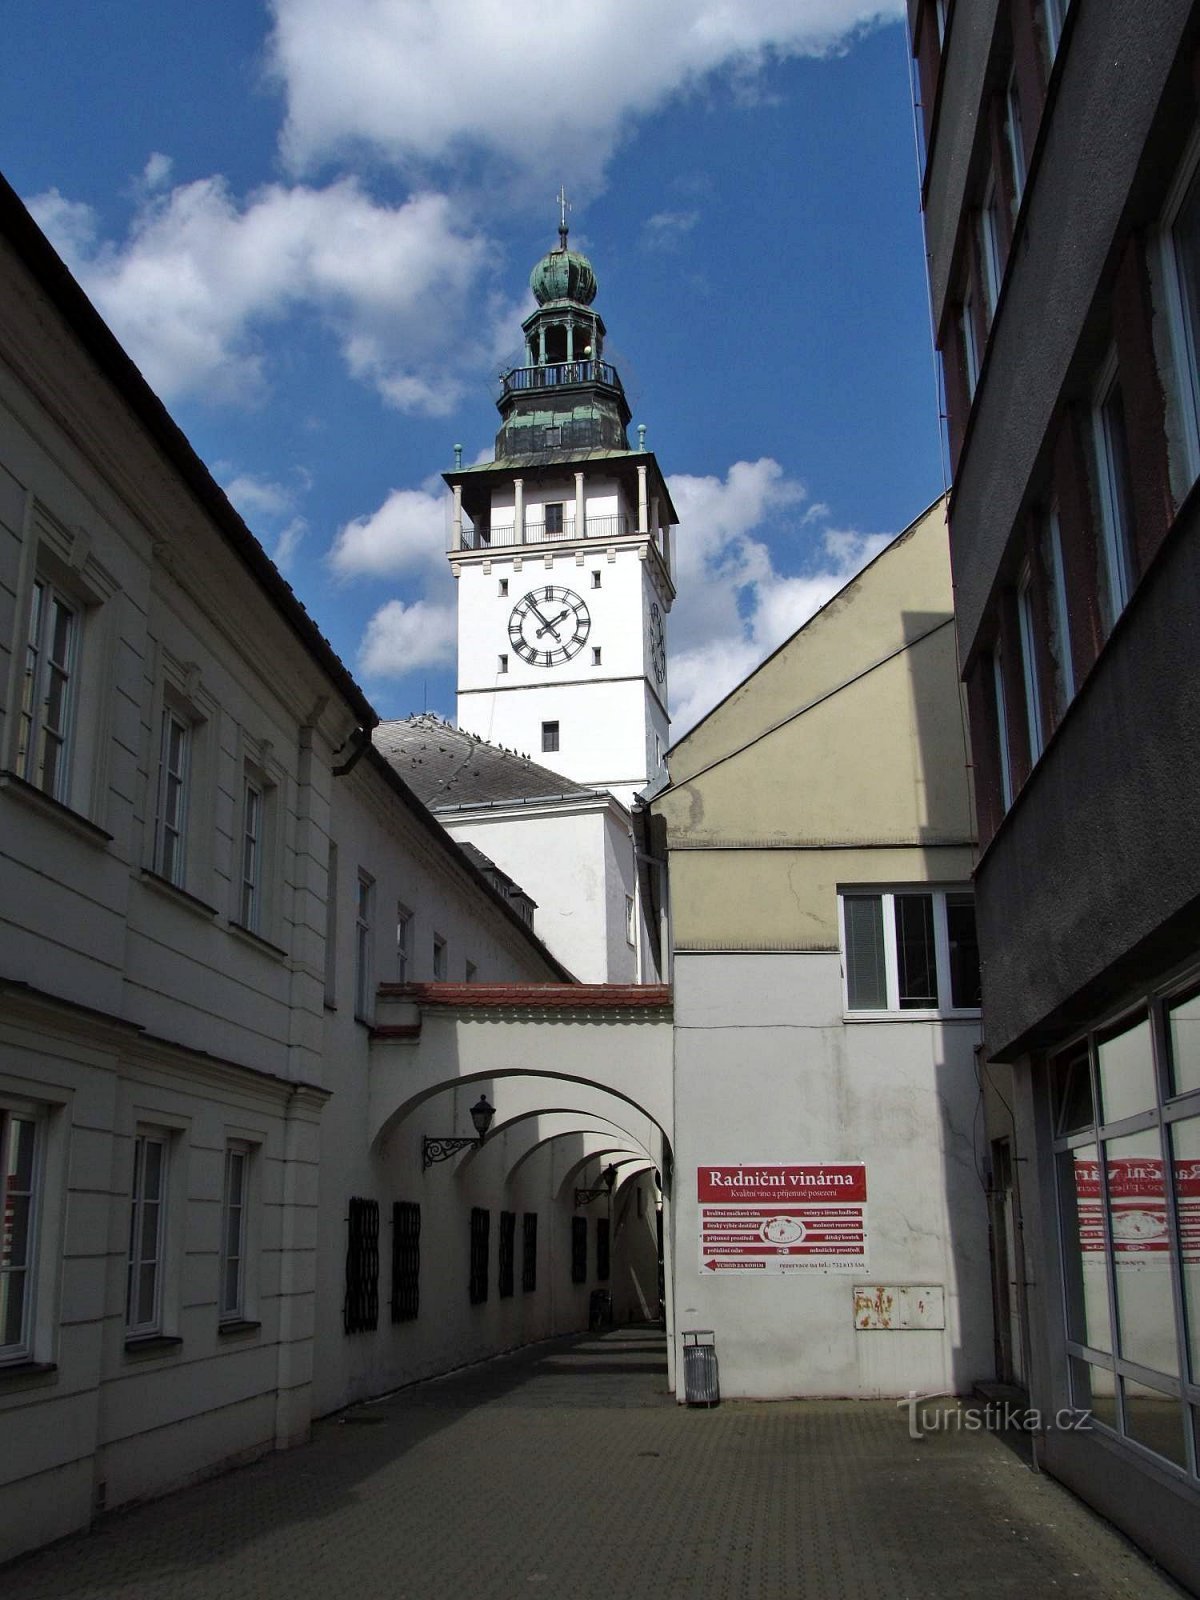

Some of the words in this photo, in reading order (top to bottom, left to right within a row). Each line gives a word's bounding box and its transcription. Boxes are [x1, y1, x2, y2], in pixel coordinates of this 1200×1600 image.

[709, 1170, 786, 1186] Radniční
[789, 1170, 854, 1186] vinárna
[731, 1189, 756, 1198] Kvalitní
[757, 1190, 771, 1198] víno
[777, 1189, 807, 1199] příjemné
[808, 1189, 837, 1199] posezení
